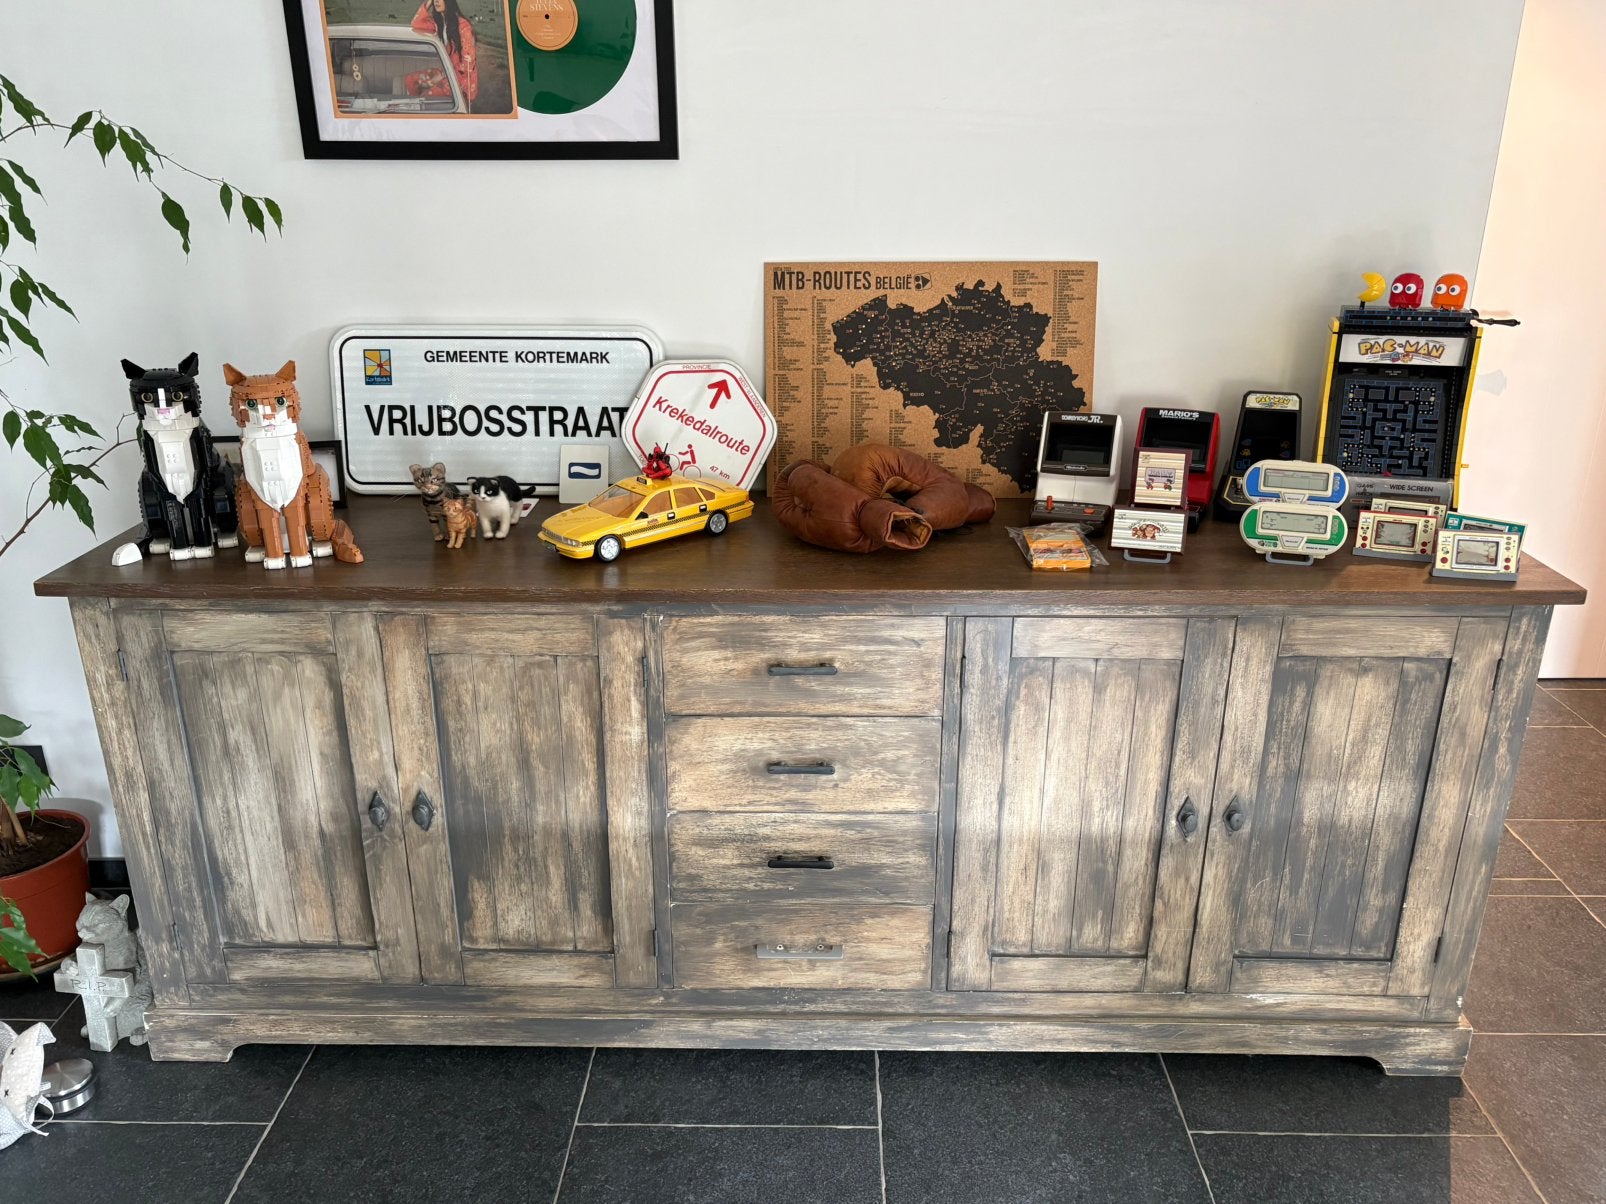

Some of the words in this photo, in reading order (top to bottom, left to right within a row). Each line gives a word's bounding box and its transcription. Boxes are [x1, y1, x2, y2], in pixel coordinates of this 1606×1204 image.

[773, 271, 872, 290] MTB-ROUTES
[875, 274, 912, 290] BELGIË
[1358, 338, 1445, 359] PAC-MAN
[424, 350, 509, 363] GEMEENTE
[515, 350, 610, 364] KORTEMARK
[1088, 415, 1104, 424] JR.
[1159, 409, 1200, 418] MARIO'S
[652, 395, 751, 456] Krekedalroute
[709, 465, 719, 473] 47
[719, 470, 731, 480] km
[1407, 485, 1434, 493] SCREEN
